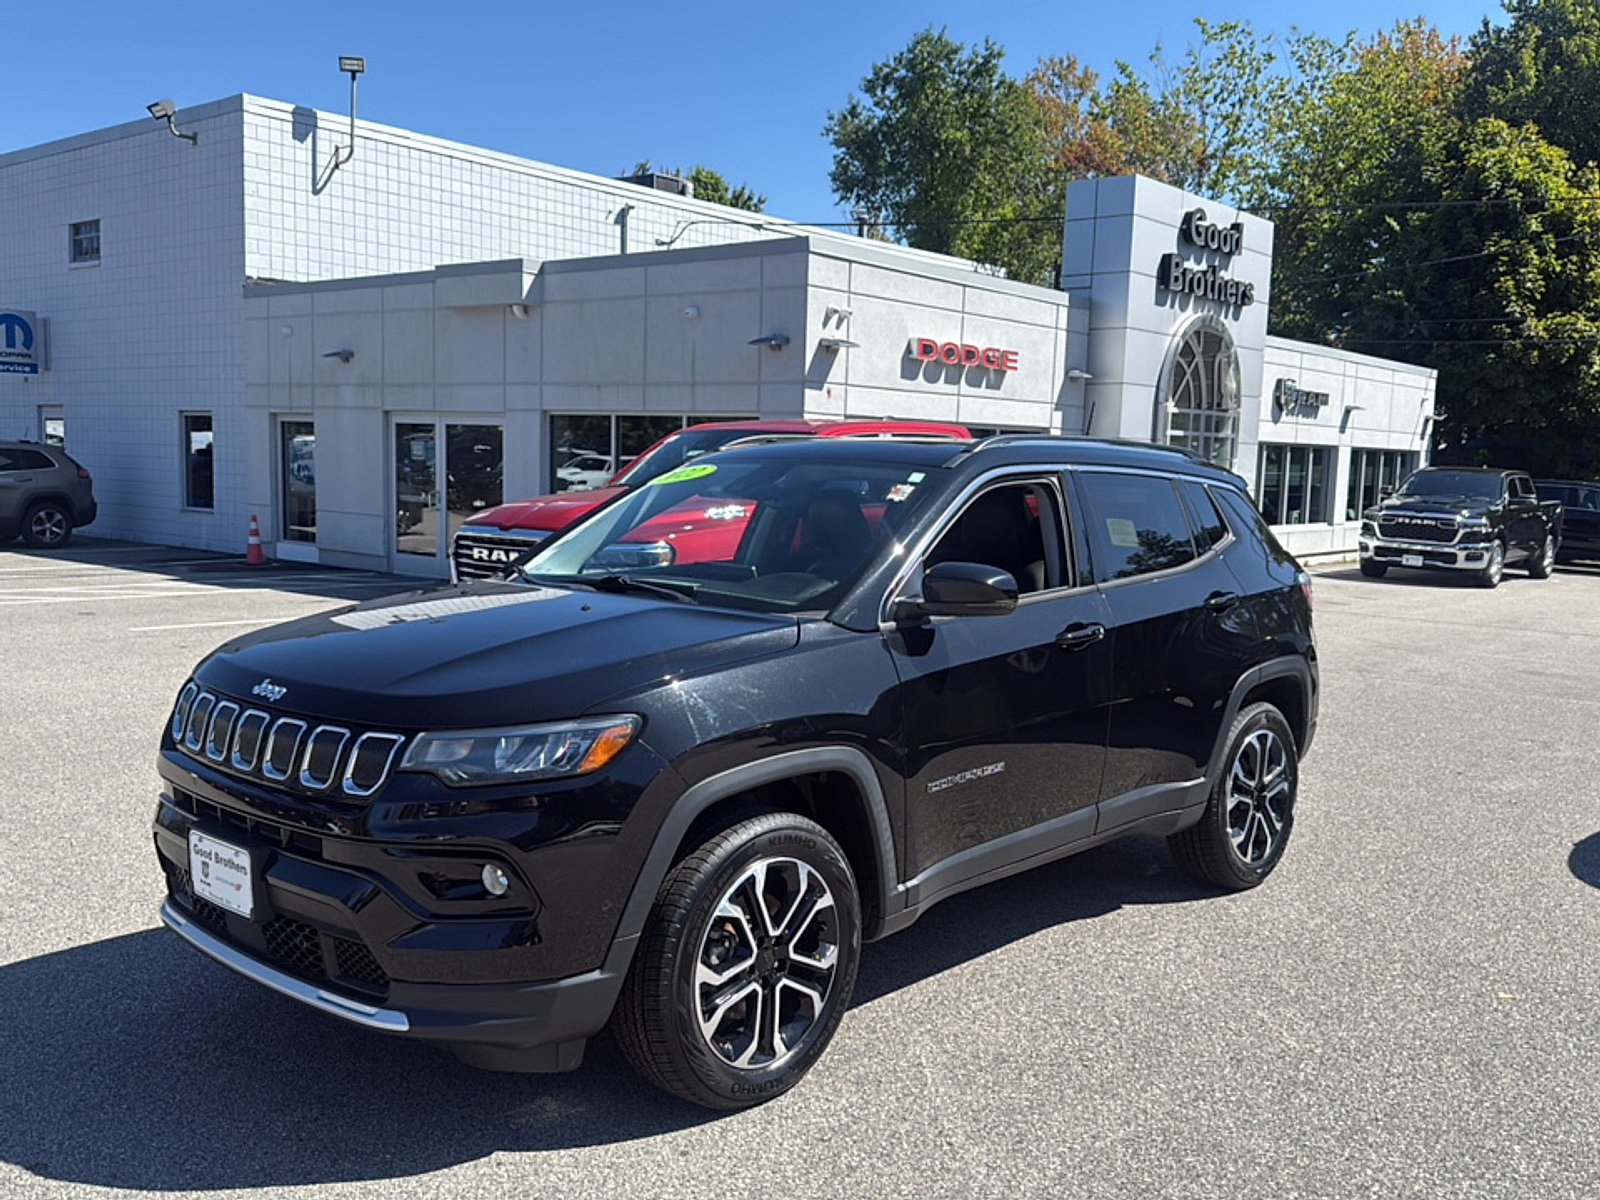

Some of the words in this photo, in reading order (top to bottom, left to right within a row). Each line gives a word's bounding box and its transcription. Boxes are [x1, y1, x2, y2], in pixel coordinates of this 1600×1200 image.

[1184, 207, 1244, 256] Good
[1165, 253, 1255, 306] Brothers
[0, 351, 33, 360] OPAR
[917, 338, 1020, 371] DODGE
[0, 364, 31, 374] ervice
[1398, 517, 1436, 526] RAM
[251, 678, 288, 702] Jeep
[768, 834, 817, 850] KUMHO
[193, 843, 213, 861] Good
[214, 850, 248, 876] Brothers
